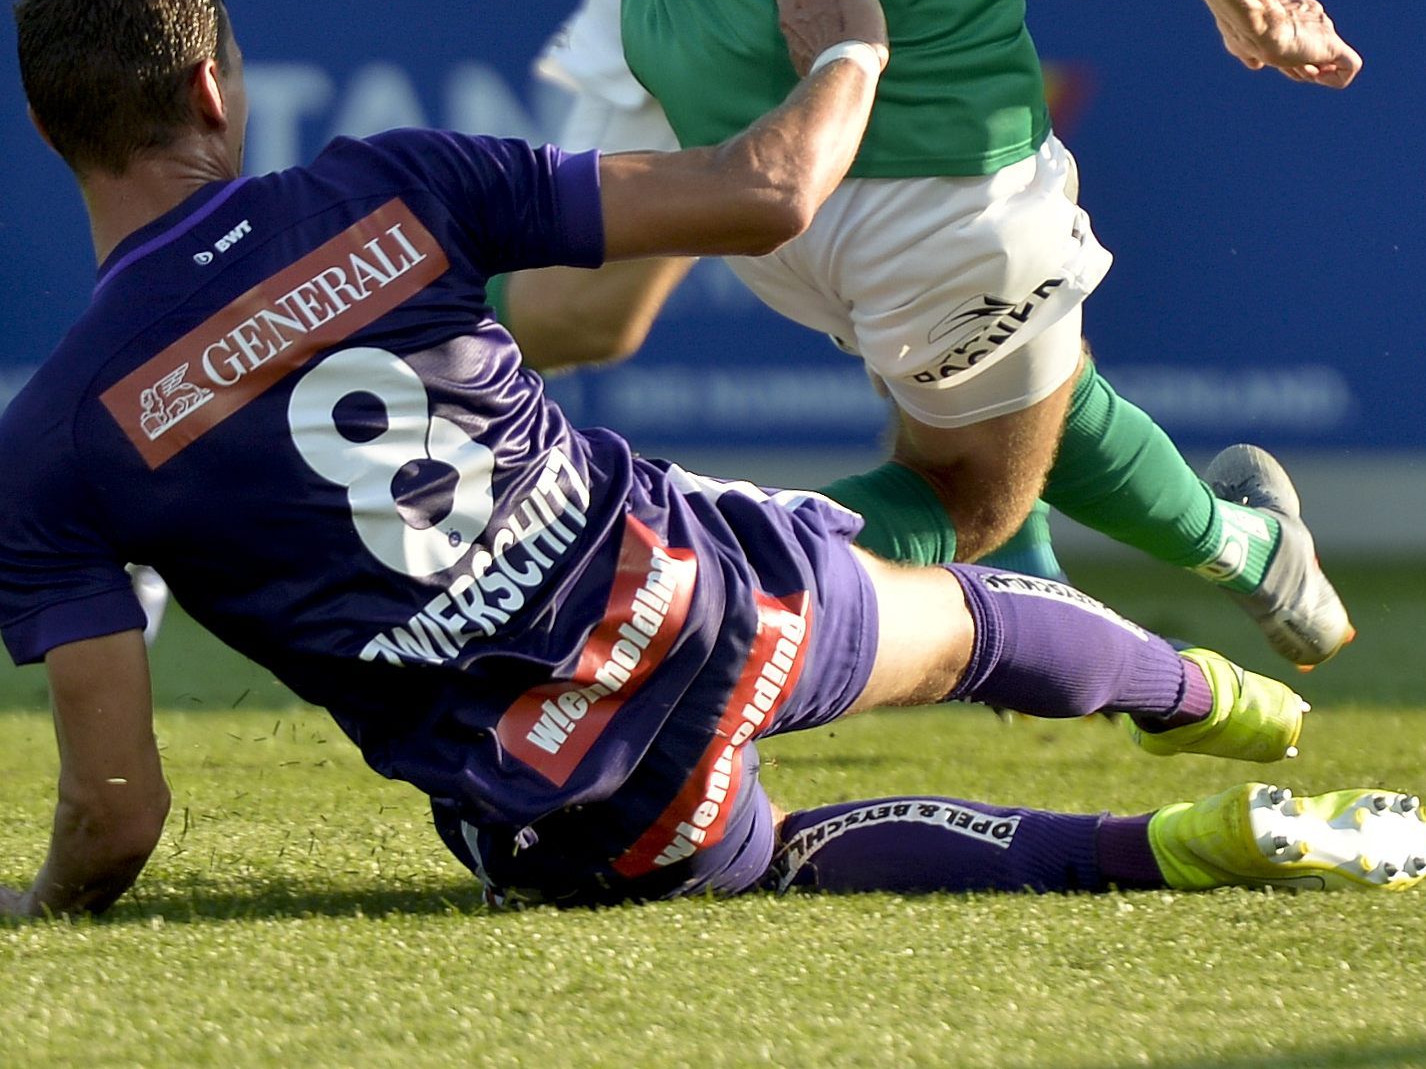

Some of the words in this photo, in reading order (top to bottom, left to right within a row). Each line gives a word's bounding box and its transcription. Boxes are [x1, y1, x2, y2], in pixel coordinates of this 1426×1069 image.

[214, 219, 252, 253] BWT
[201, 223, 426, 387] GENERALI
[288, 347, 495, 577] 8
[917, 803, 940, 818] &
[945, 805, 1014, 841] OPEL
